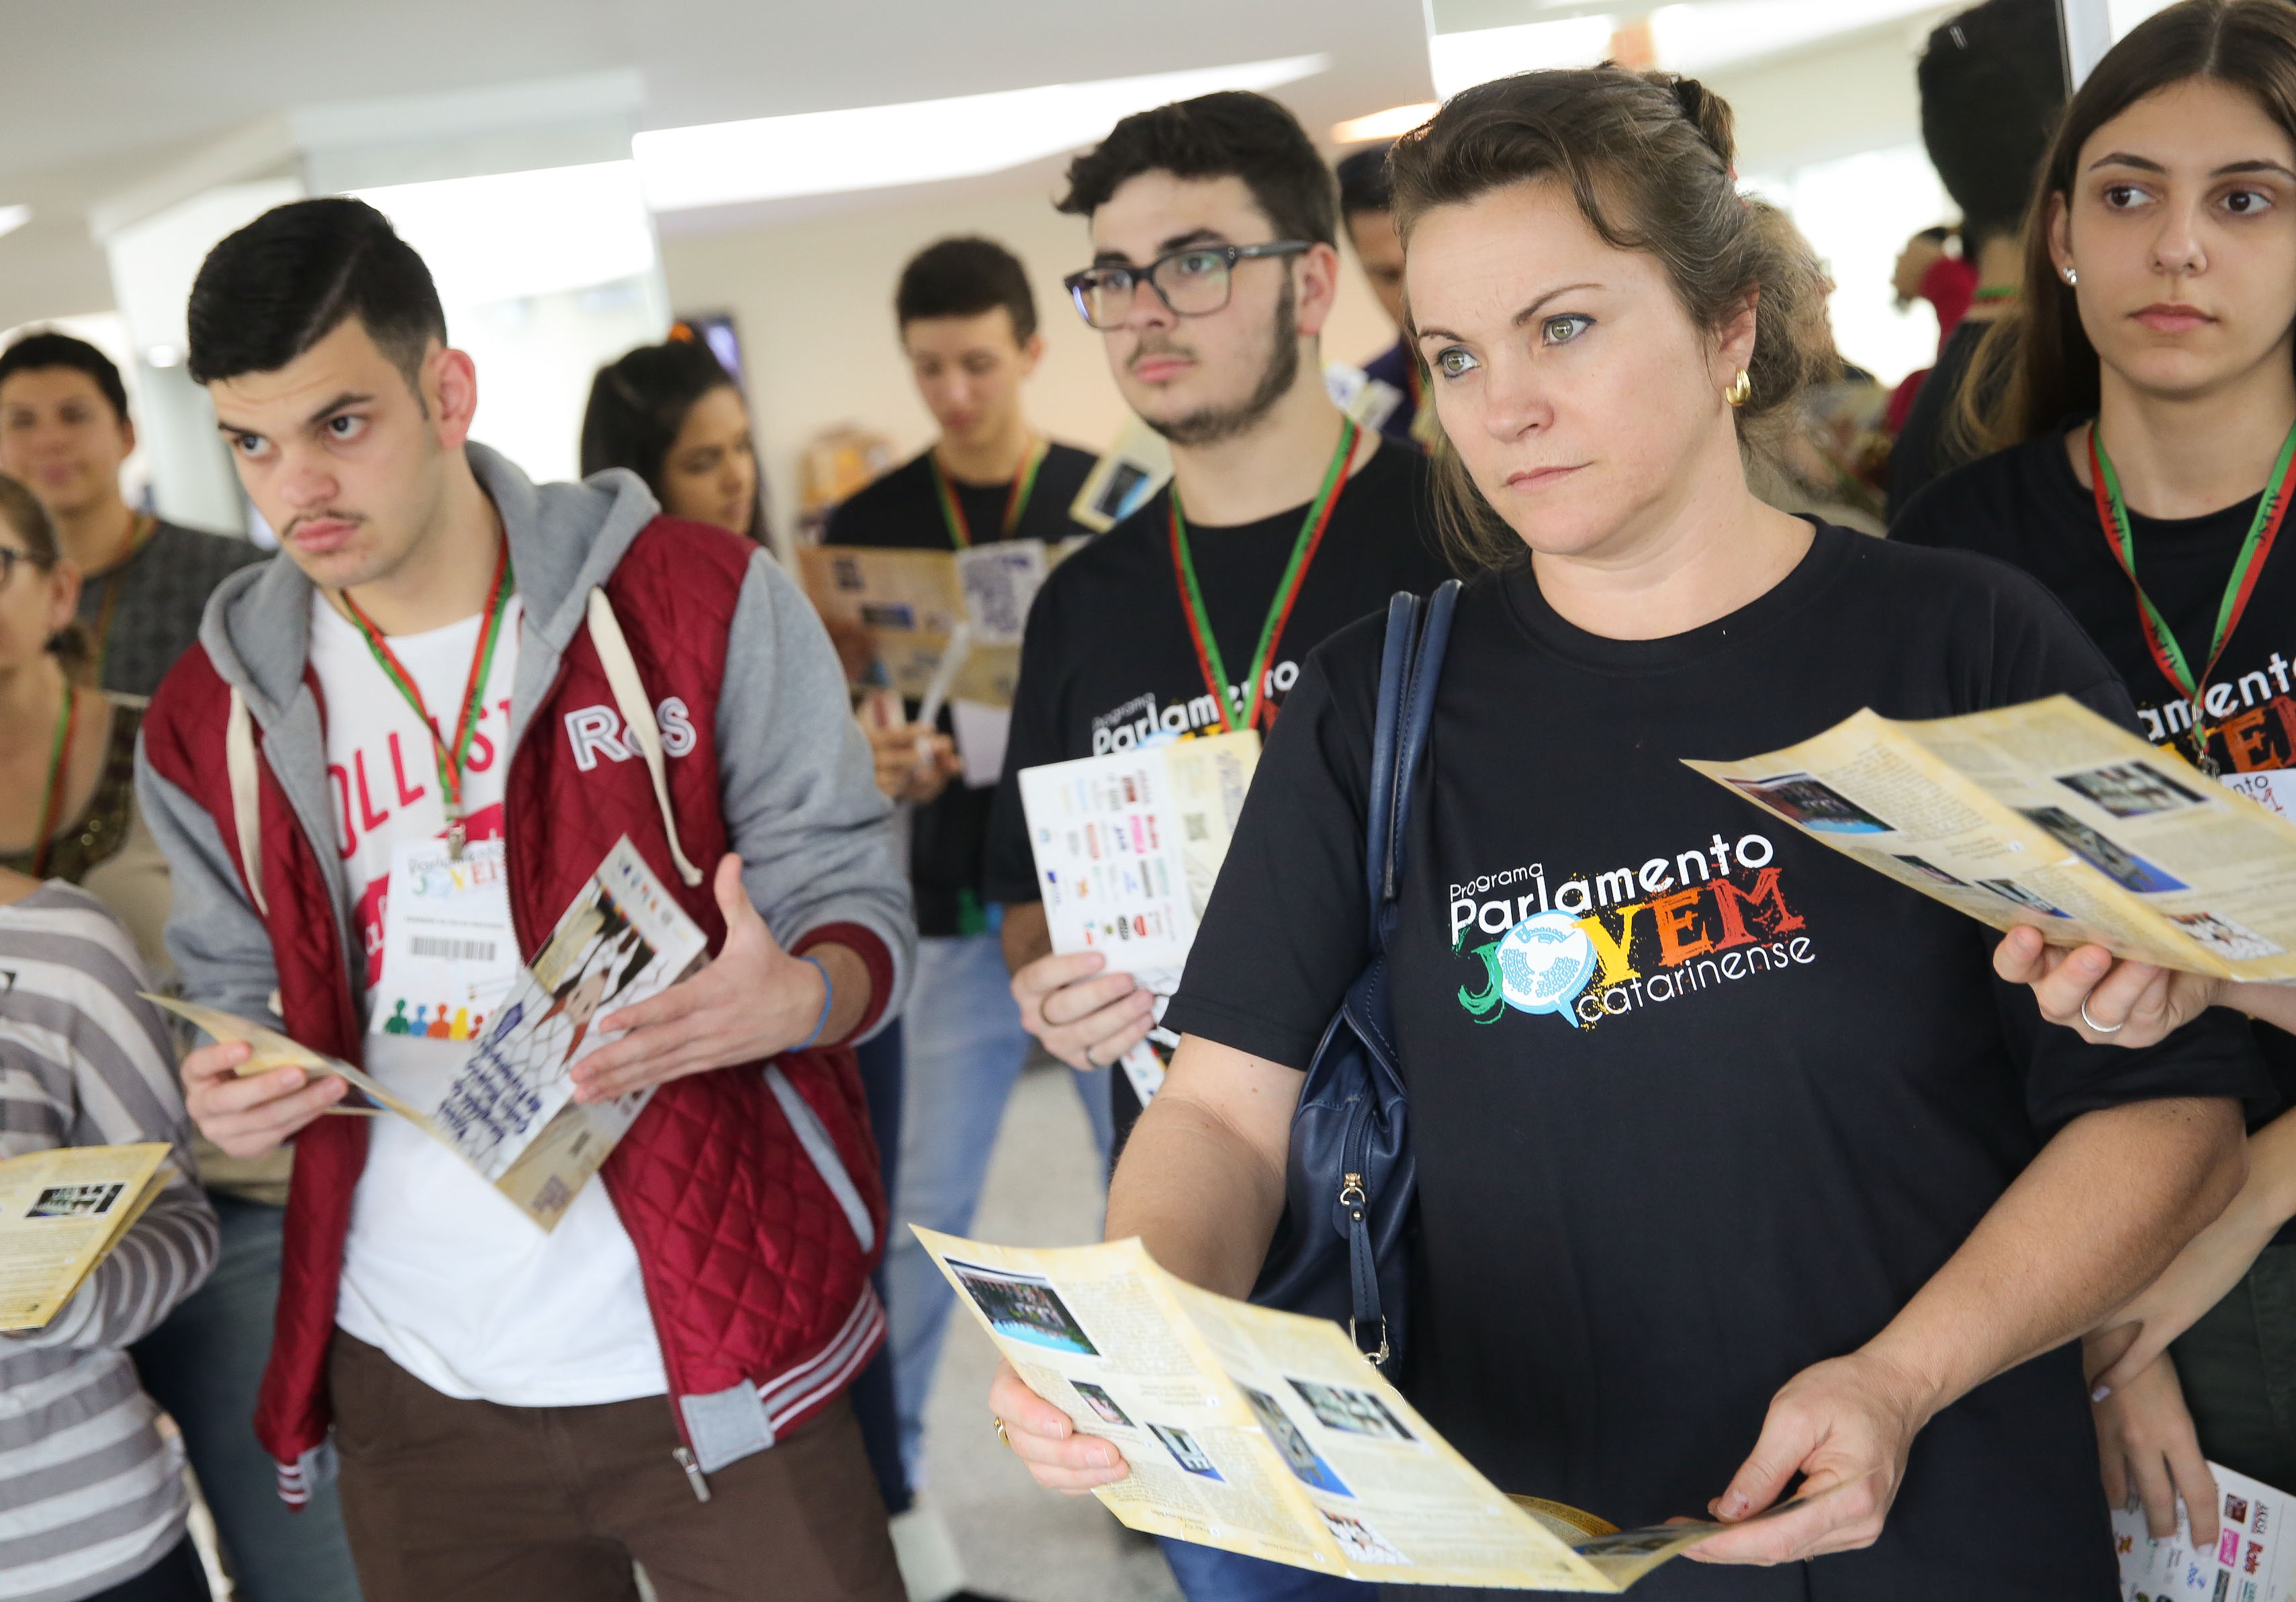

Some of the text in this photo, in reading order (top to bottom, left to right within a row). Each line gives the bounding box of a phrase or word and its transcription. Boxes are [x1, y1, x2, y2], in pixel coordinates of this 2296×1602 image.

[1450, 862, 1544, 903] Programa
[1451, 834, 1774, 946] Parlamento
[1457, 868, 1806, 1025] JOVEM
[1578, 937, 1816, 1022] catarinense
